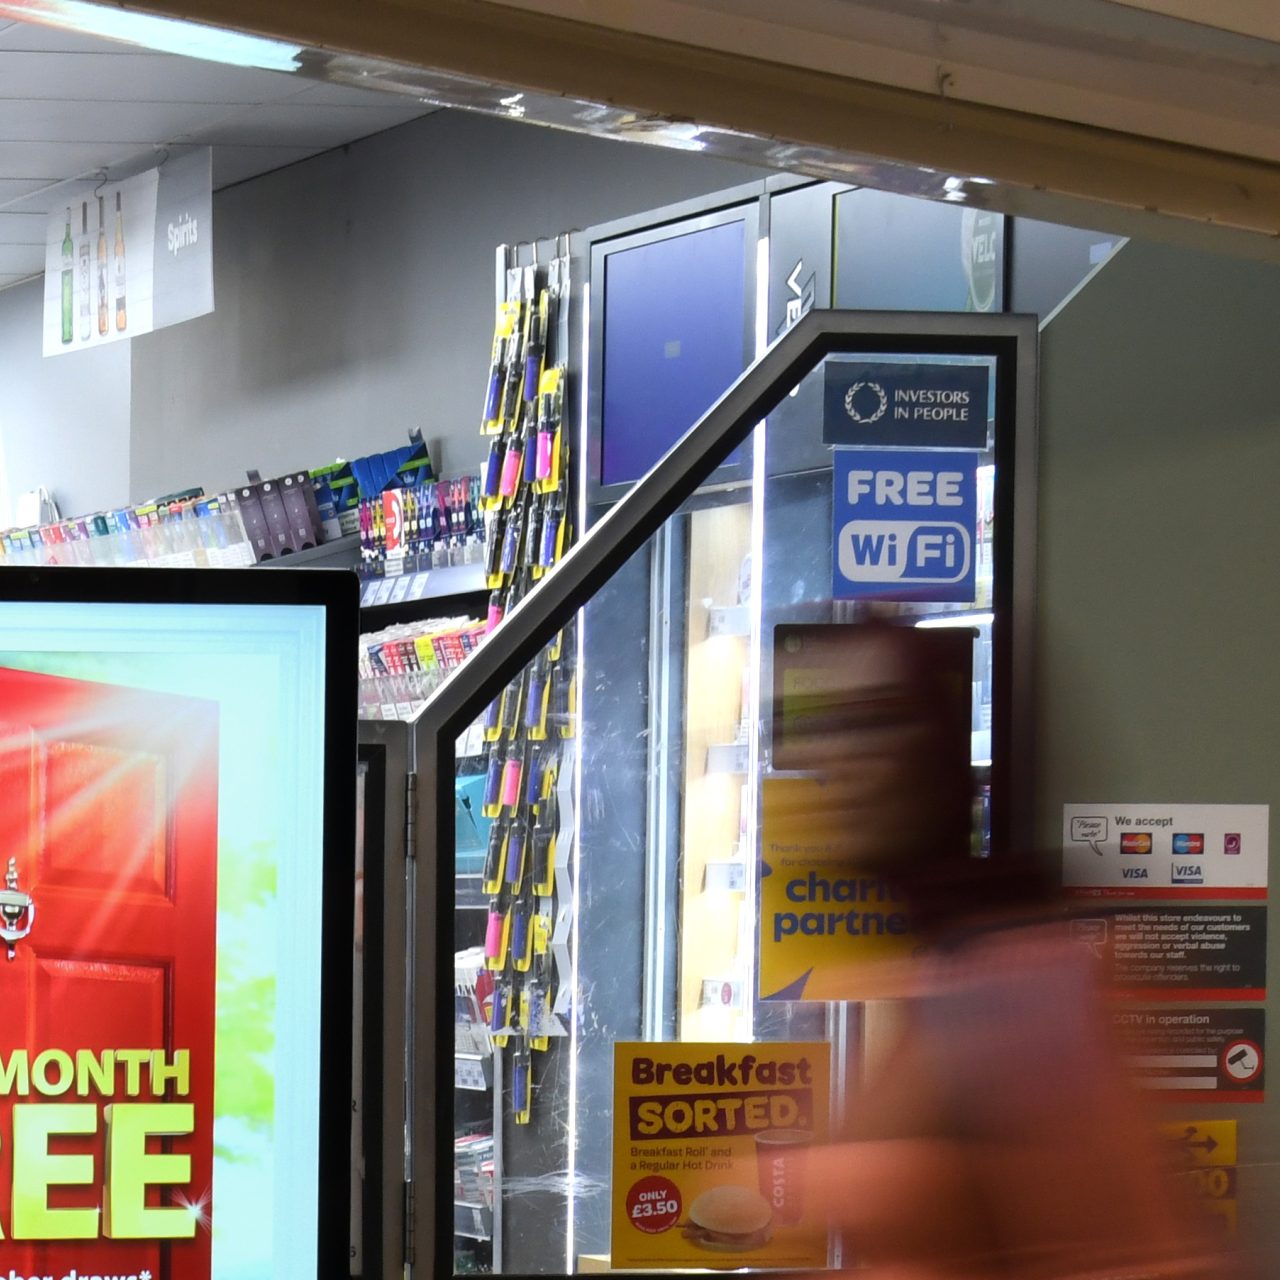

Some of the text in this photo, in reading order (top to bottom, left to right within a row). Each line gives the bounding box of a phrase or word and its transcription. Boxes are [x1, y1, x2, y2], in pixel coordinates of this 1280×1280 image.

[168, 212, 197, 256] Spirits
[894, 389, 970, 404] INVESTORS
[894, 406, 969, 421] IN PEOPLE
[847, 470, 964, 506] FREE
[1115, 816, 1173, 828] We accept
[1122, 868, 1148, 878] VISA
[1176, 865, 1201, 876] VISA
[1233, 914, 1242, 922] to
[773, 909, 910, 942] partne
[1145, 1015, 1156, 1024] in
[1158, 1015, 1210, 1025] operation
[631, 1054, 813, 1087] Breakfast
[630, 1147, 732, 1157] Breakfast and
[630, 1162, 637, 1170] a
[639, 1160, 680, 1172] Regular
[682, 1160, 704, 1170] Hot
[773, 1157, 785, 1208] COSTA
[639, 1189, 668, 1201] ONLY
[631, 1200, 679, 1218] £3.50
